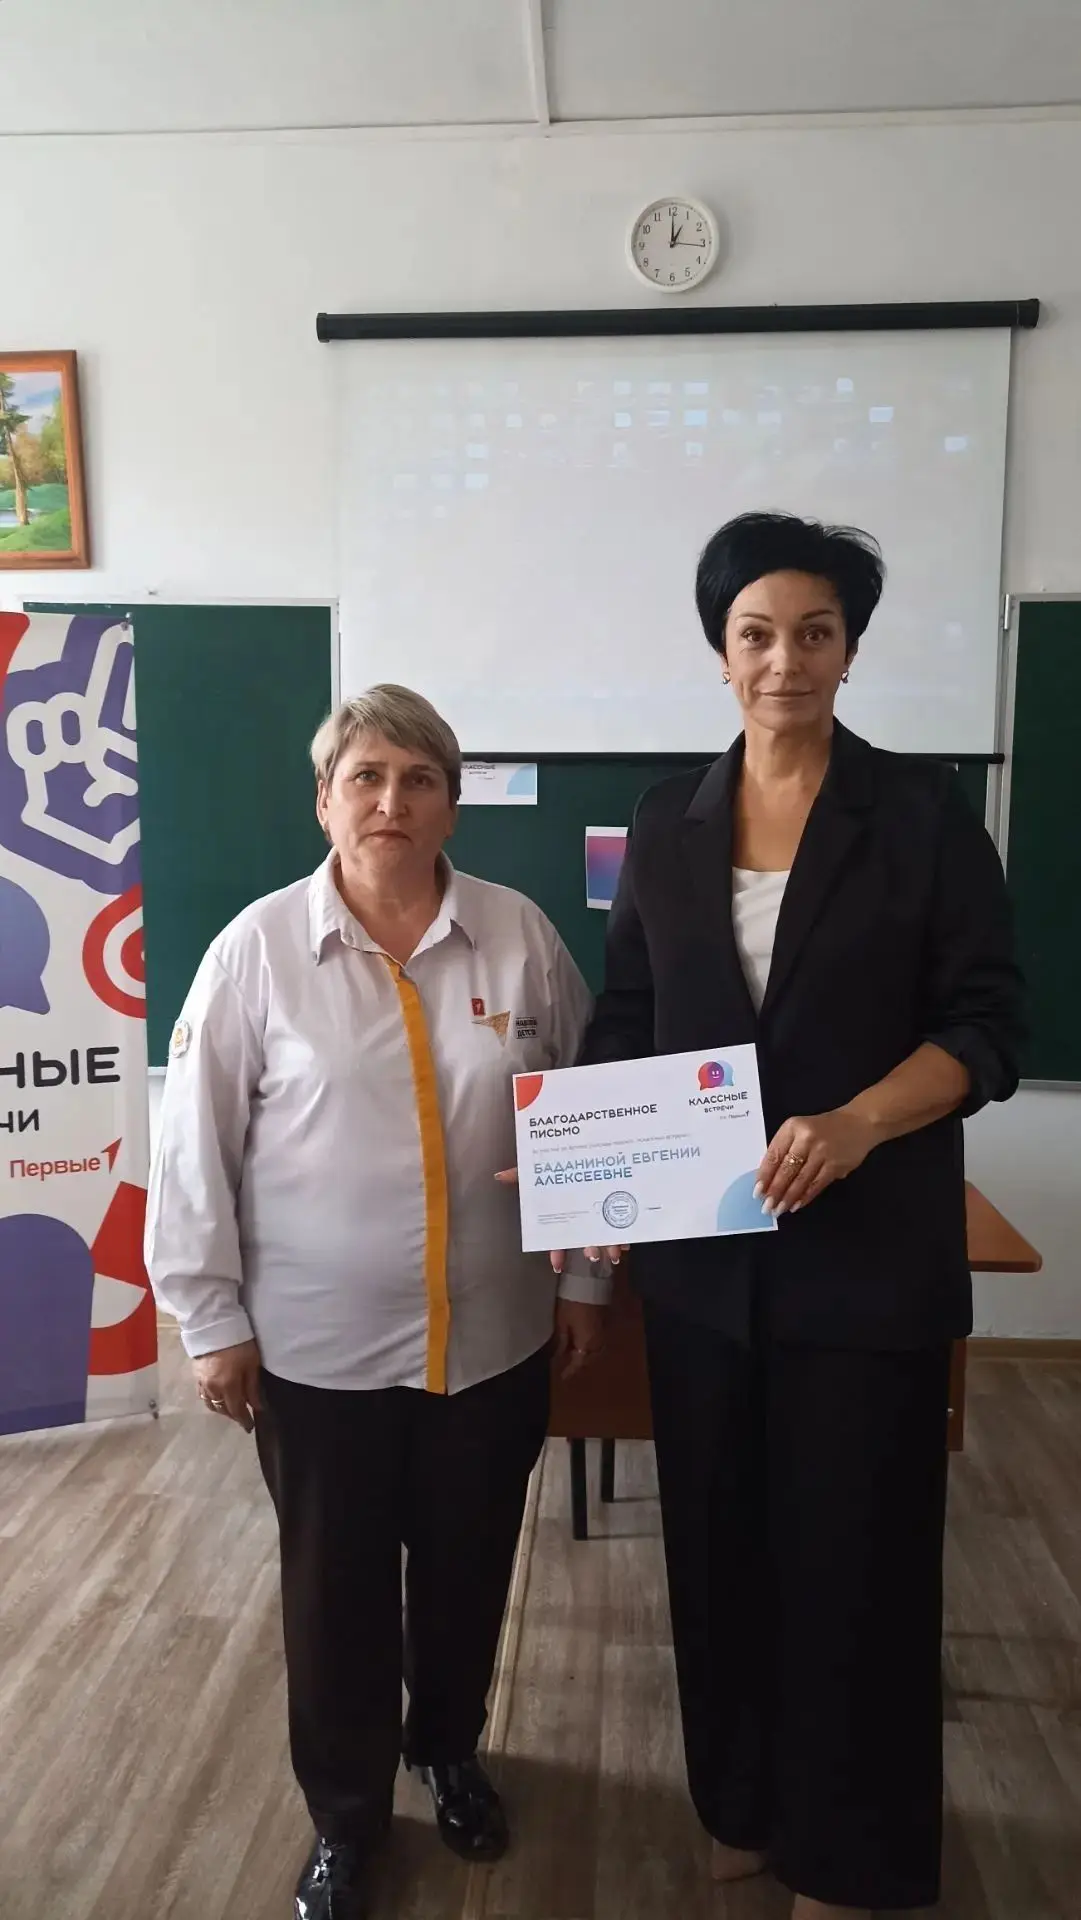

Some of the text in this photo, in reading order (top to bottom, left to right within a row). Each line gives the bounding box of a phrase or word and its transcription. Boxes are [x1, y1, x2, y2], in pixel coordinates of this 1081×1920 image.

[654, 212, 661, 222] 11
[668, 206, 678, 217] 12
[642, 224, 651, 235] 10
[696, 222, 703, 232] 2
[638, 241, 645, 251] 9
[700, 238, 706, 248] 3
[643, 257, 649, 268] 8
[695, 255, 701, 265] 4
[654, 268, 661, 278] 7
[669, 272, 676, 282] 6
[684, 267, 691, 277] 5
[688, 1091, 748, 1106] КЛАССНЫЕ
[529, 1104, 658, 1127] БЛАГОДАРСТВЕННОЕ
[530, 1126, 580, 1139] ПИСЬМО
[534, 1146, 701, 1174] БАДАНИНОЙ ЕВГЕНИИ
[10, 1157, 101, 1181] Первые
[534, 1167, 633, 1187] АЛЕКСЕЕВНЕ
